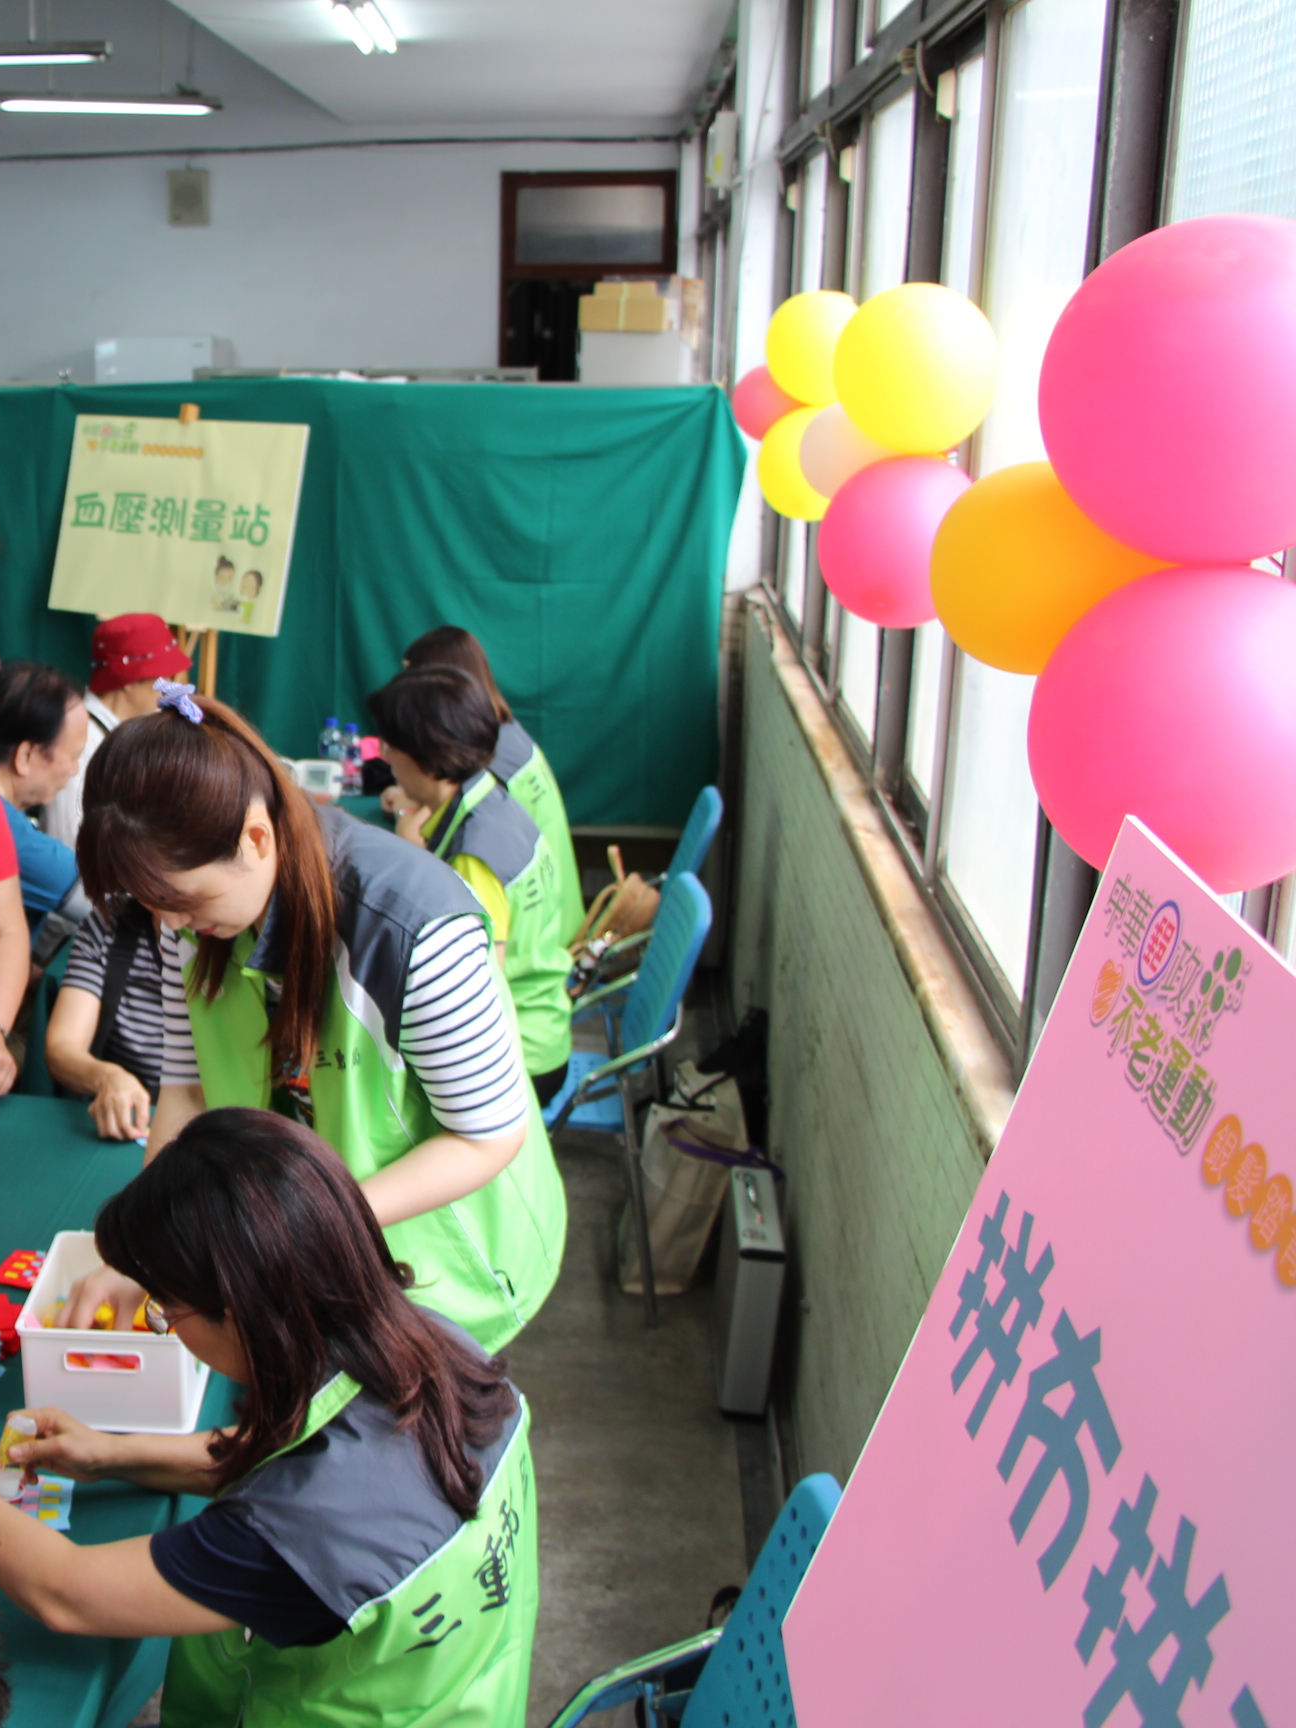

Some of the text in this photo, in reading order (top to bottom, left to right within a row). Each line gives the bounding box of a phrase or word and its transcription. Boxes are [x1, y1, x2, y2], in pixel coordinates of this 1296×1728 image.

[70, 491, 271, 547] 血壓測量站
[1107, 985, 1217, 1152] 不老運動
[949, 1189, 1270, 1728] 拼布拼
